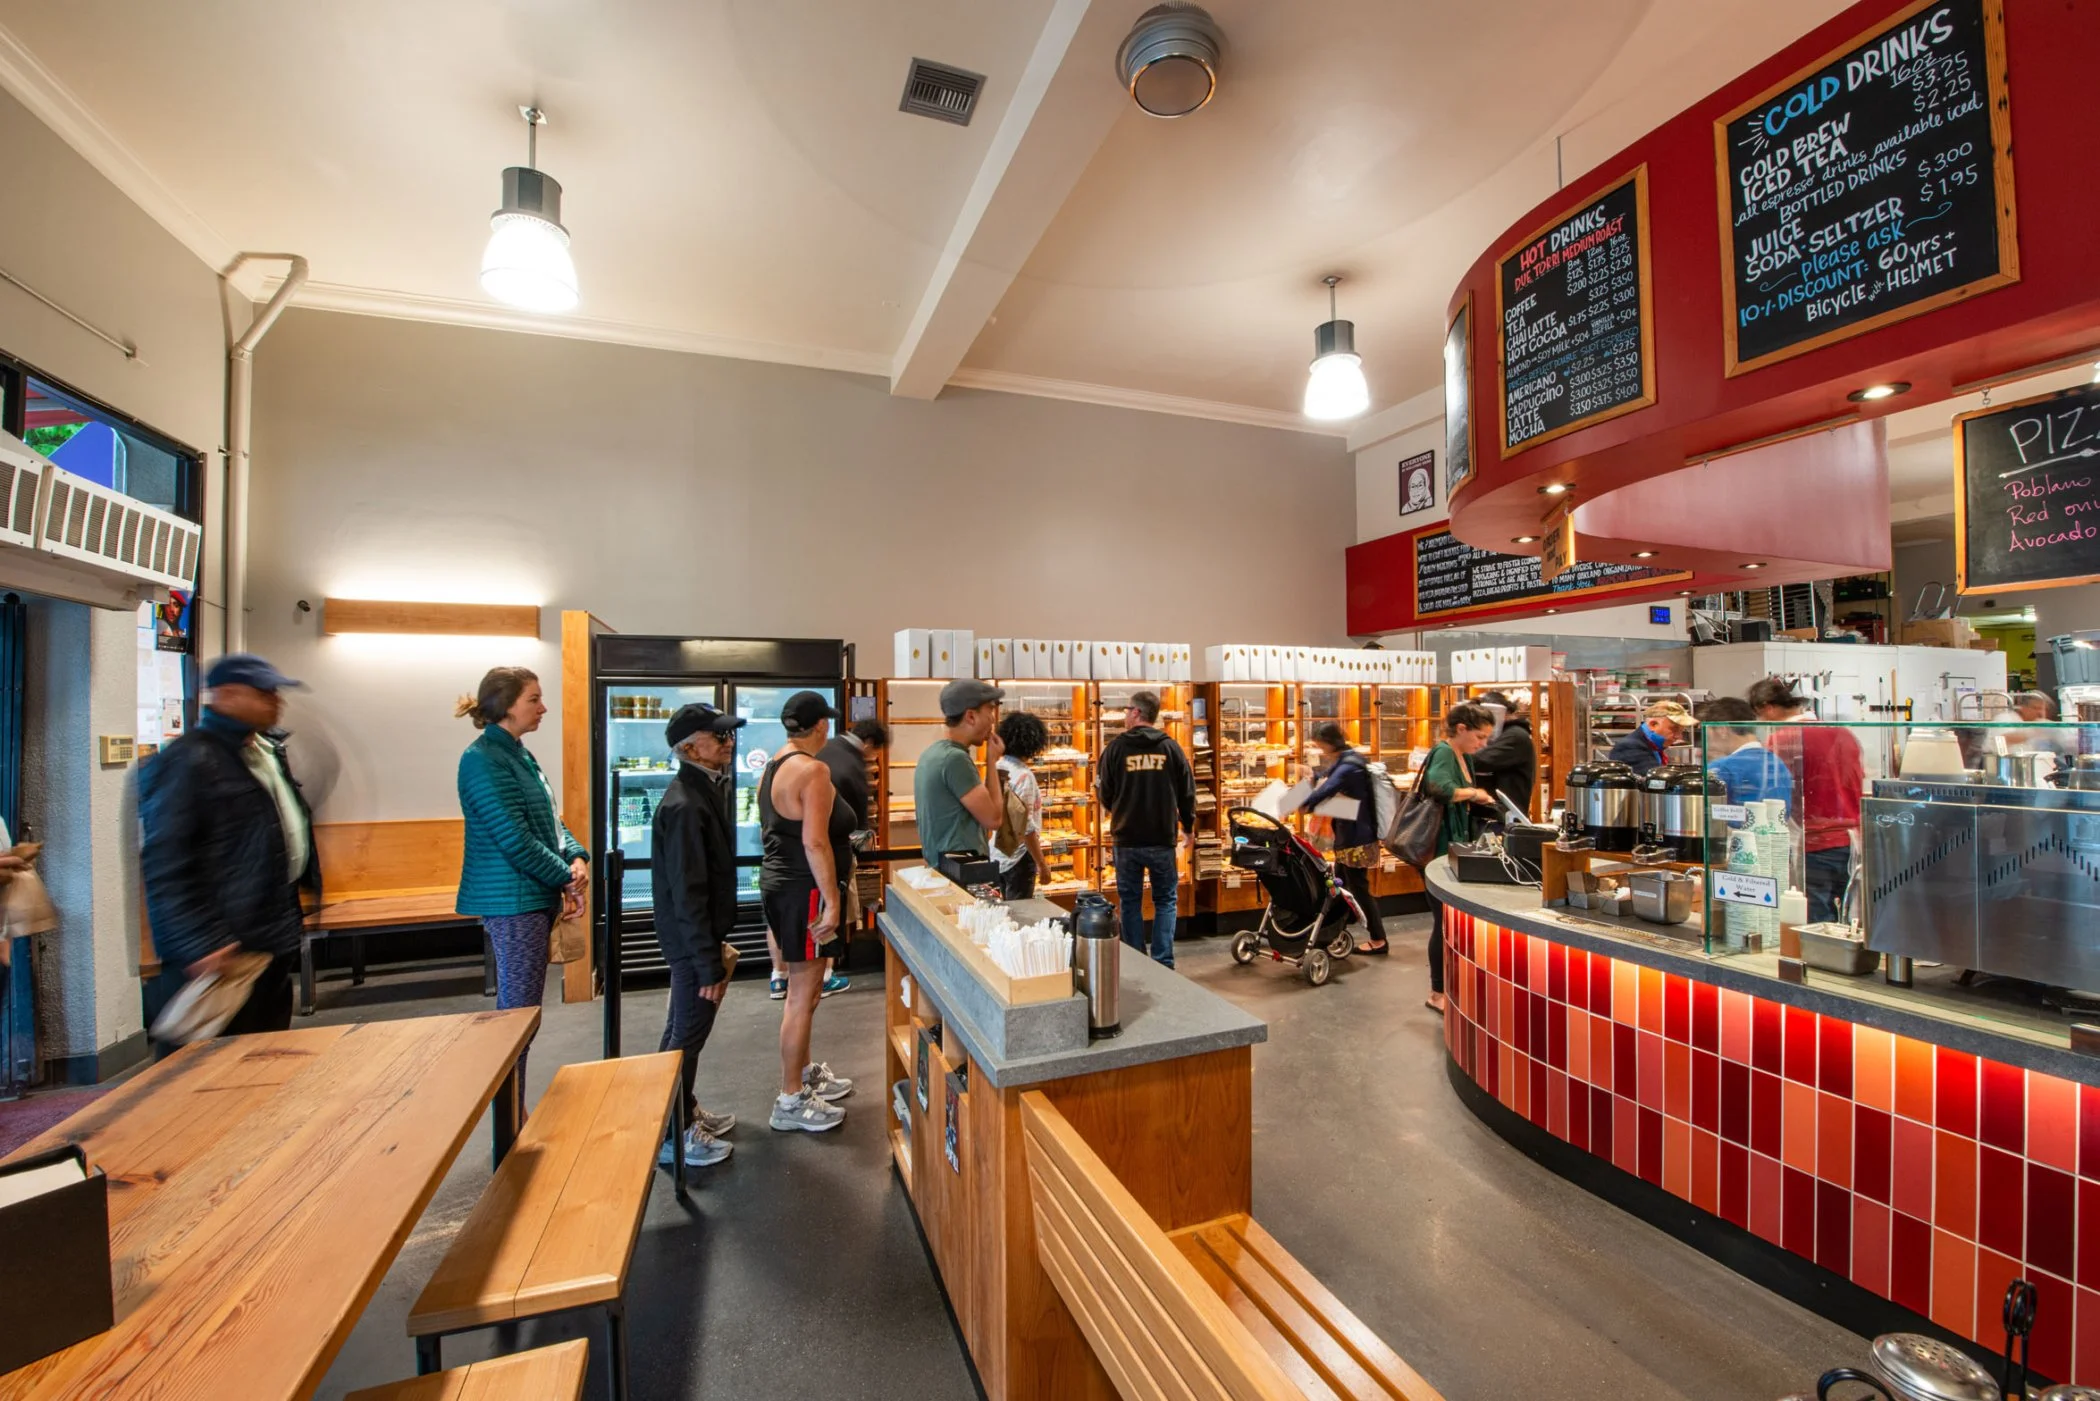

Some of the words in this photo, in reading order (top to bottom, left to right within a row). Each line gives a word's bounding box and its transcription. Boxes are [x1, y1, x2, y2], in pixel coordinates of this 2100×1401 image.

[1764, 76, 1840, 136] COLD
[1846, 8, 1954, 92] DRINKS
[1741, 147, 1789, 187] COLD
[1792, 111, 1851, 161] BREW
[1912, 50, 1968, 92] $3.25
[1743, 168, 1791, 206] ICED
[1796, 137, 1849, 176] TEA
[1913, 70, 1971, 112] $2.25
[1734, 203, 1760, 227] all
[1761, 174, 1815, 211] espresso
[1822, 150, 1867, 181] drinks
[1870, 113, 1944, 162] available
[1947, 90, 1984, 121] iced
[1780, 181, 1845, 225] BOTTLED
[1847, 149, 1907, 191] DRINKS
[1520, 239, 1547, 271] HOT
[1550, 204, 1606, 252] DRINKS
[1745, 244, 1802, 282] SODA
[1808, 197, 1905, 253] SELTZER
[1745, 218, 1805, 262] JUICE
[1867, 219, 1906, 250] ask
[1514, 270, 1534, 292] DUE
[1562, 234, 1595, 262] MEDIUM
[1595, 215, 1624, 243] ROAST
[1867, 279, 1886, 302] with
[1887, 247, 1957, 292] HELMET
[1504, 292, 1538, 323] COFFEE
[1506, 315, 1526, 337] TEA
[1506, 328, 1527, 352] CHAI
[1527, 310, 1558, 339] LATTE
[1507, 342, 1528, 366] HOT
[1528, 321, 1568, 353] COCOA
[1507, 371, 1557, 407] AMERICANO
[1508, 407, 1540, 433] LATTE
[1508, 419, 1546, 447] MOCHA
[2003, 473, 2092, 500] Poblano
[2006, 501, 2050, 527] Red
[2008, 519, 2097, 552] Avocado
[1480, 563, 1496, 572] STRIVE
[1496, 562, 1503, 570] TO
[1502, 558, 1521, 568] FOSTER
[1506, 575, 1516, 583] ARE
[1516, 573, 1529, 582] ABLE
[1559, 573, 1576, 584] MANY
[1576, 569, 1602, 580] OAKLAND
[1552, 583, 1574, 593] Thank
[1126, 753, 1167, 772] STAFF
[1736, 884, 1756, 892] Water
[1745, 878, 1771, 886] Filtered
[802, 1109, 815, 1119] N
